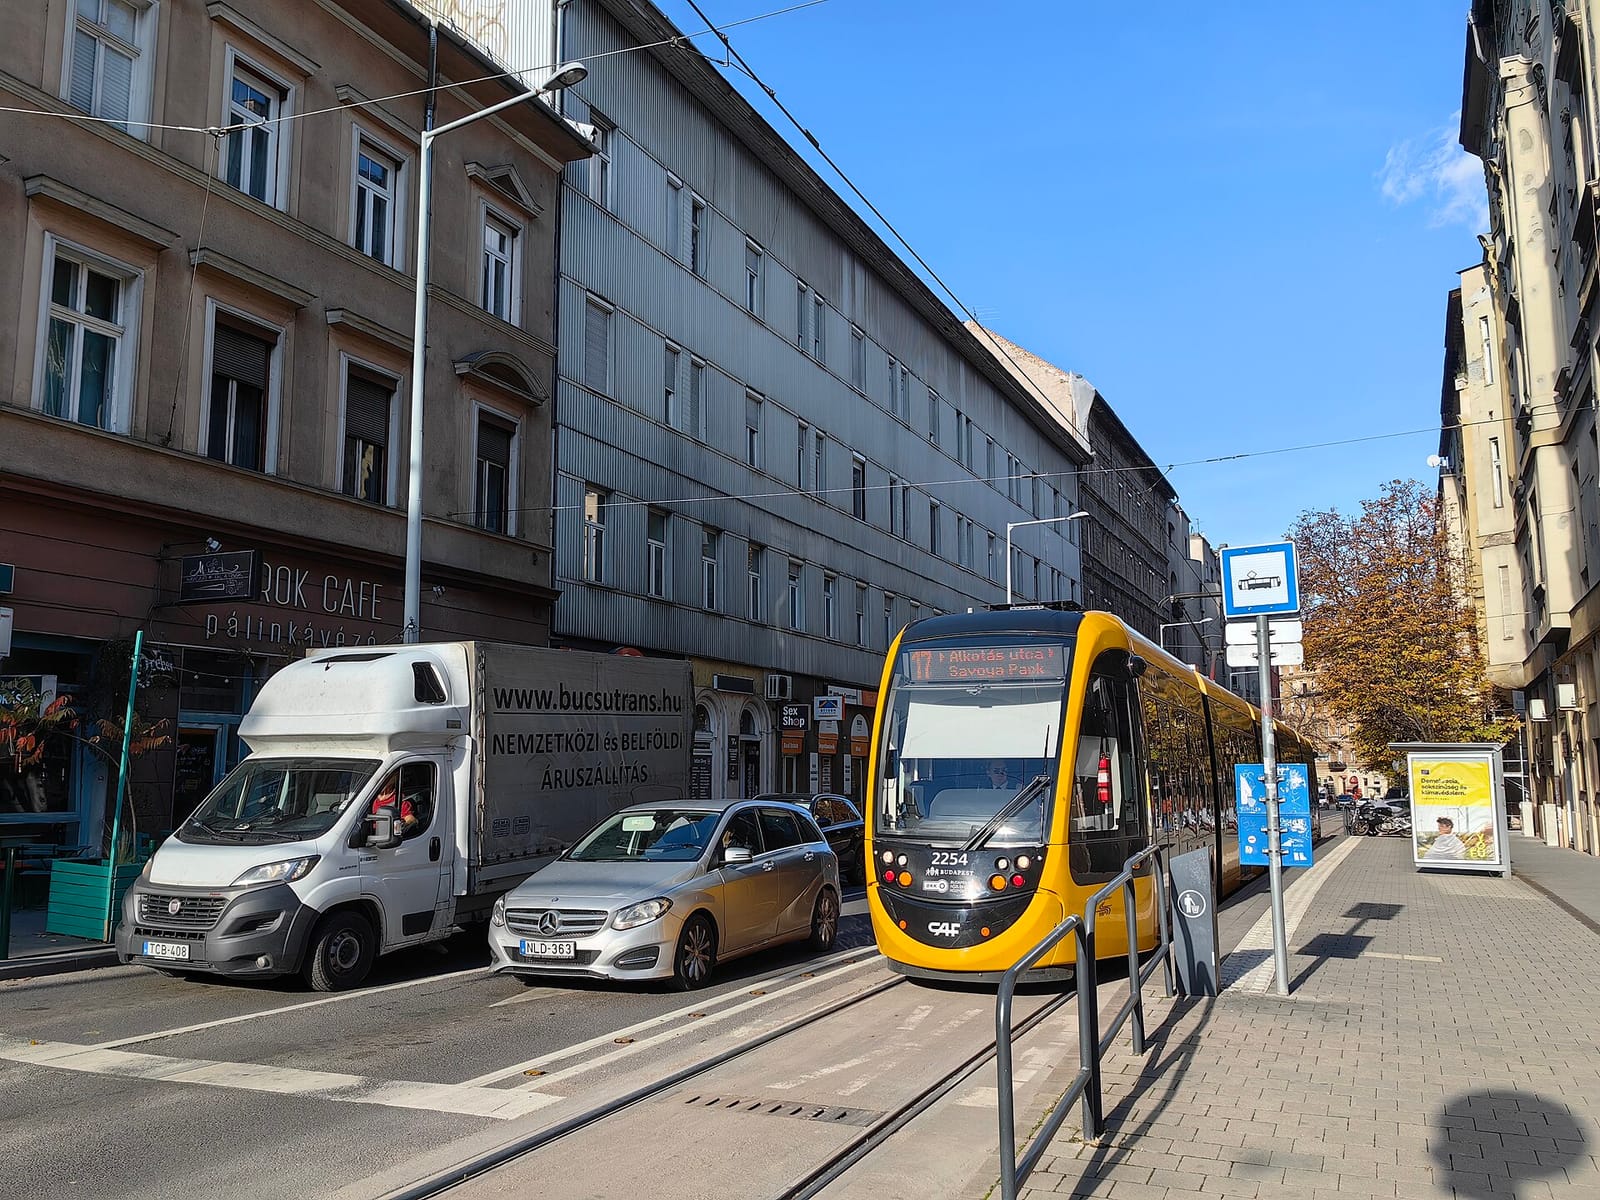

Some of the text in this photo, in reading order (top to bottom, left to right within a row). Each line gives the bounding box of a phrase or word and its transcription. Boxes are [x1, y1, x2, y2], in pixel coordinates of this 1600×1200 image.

[323, 575, 383, 620] CAFE
[206, 611, 376, 648] pálinkávézó
[911, 651, 932, 681] 17
[950, 650, 1004, 663] Alkotás
[950, 664, 1005, 678] Savoya
[493, 682, 682, 713] www.bucsutrans.hu
[782, 706, 798, 716] Sex
[782, 716, 805, 728] Shop
[492, 728, 683, 755] NEMZETKÖZI és BELFÖLDI
[541, 760, 648, 790] ÁRUSZÁLLÍTÁS
[931, 852, 969, 866] 2254
[940, 869, 975, 877] BUDAPEST
[150, 943, 187, 957] TCB-408
[526, 942, 572, 955] NLD-363
